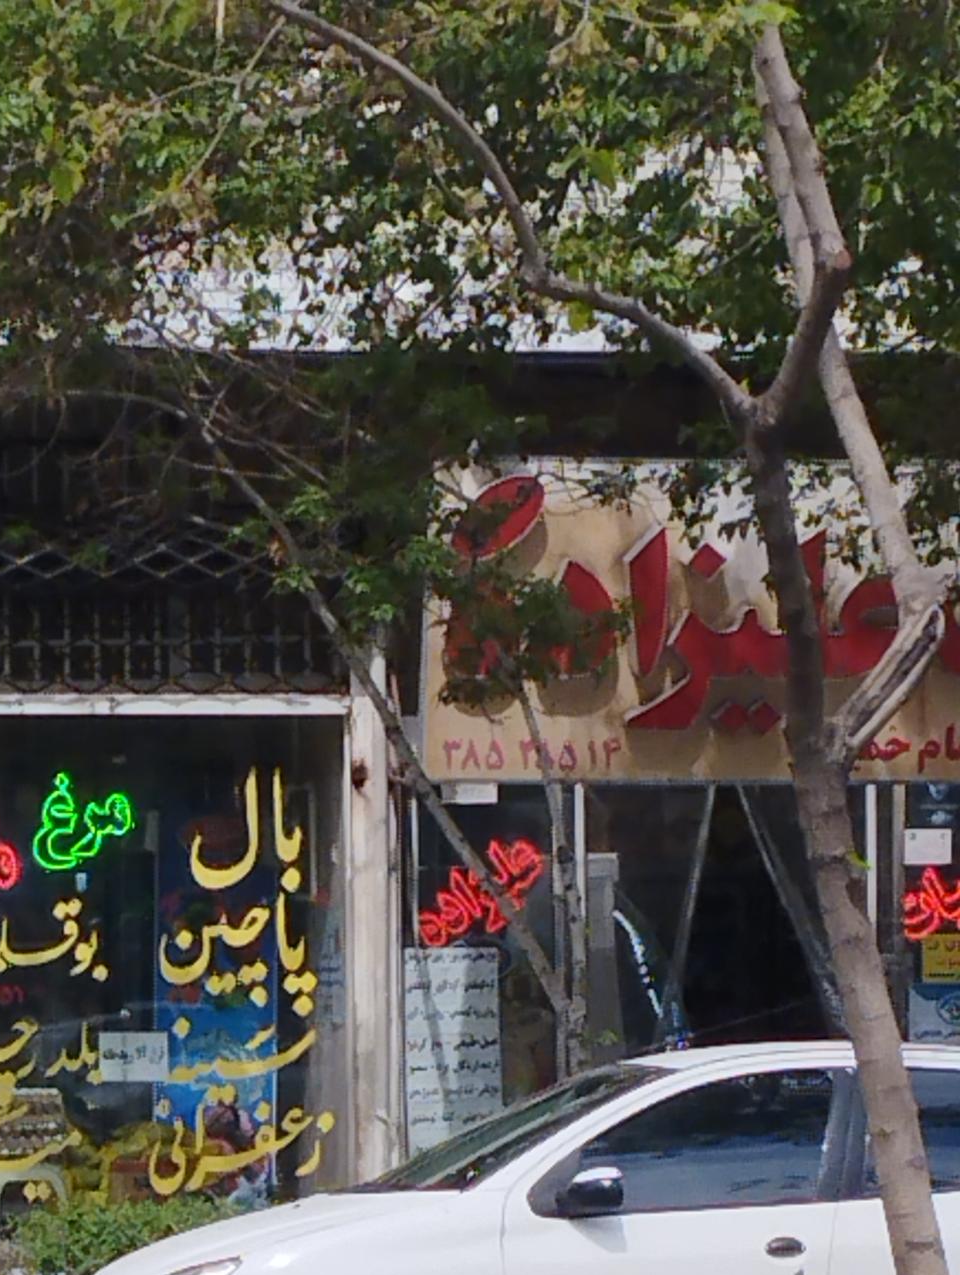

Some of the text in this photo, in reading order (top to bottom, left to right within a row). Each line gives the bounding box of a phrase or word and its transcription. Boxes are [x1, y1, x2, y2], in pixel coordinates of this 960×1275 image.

[33, 772, 134, 870] مرغ
[190, 766, 303, 893] بال
[149, 1099, 335, 1197] زعفرانی
